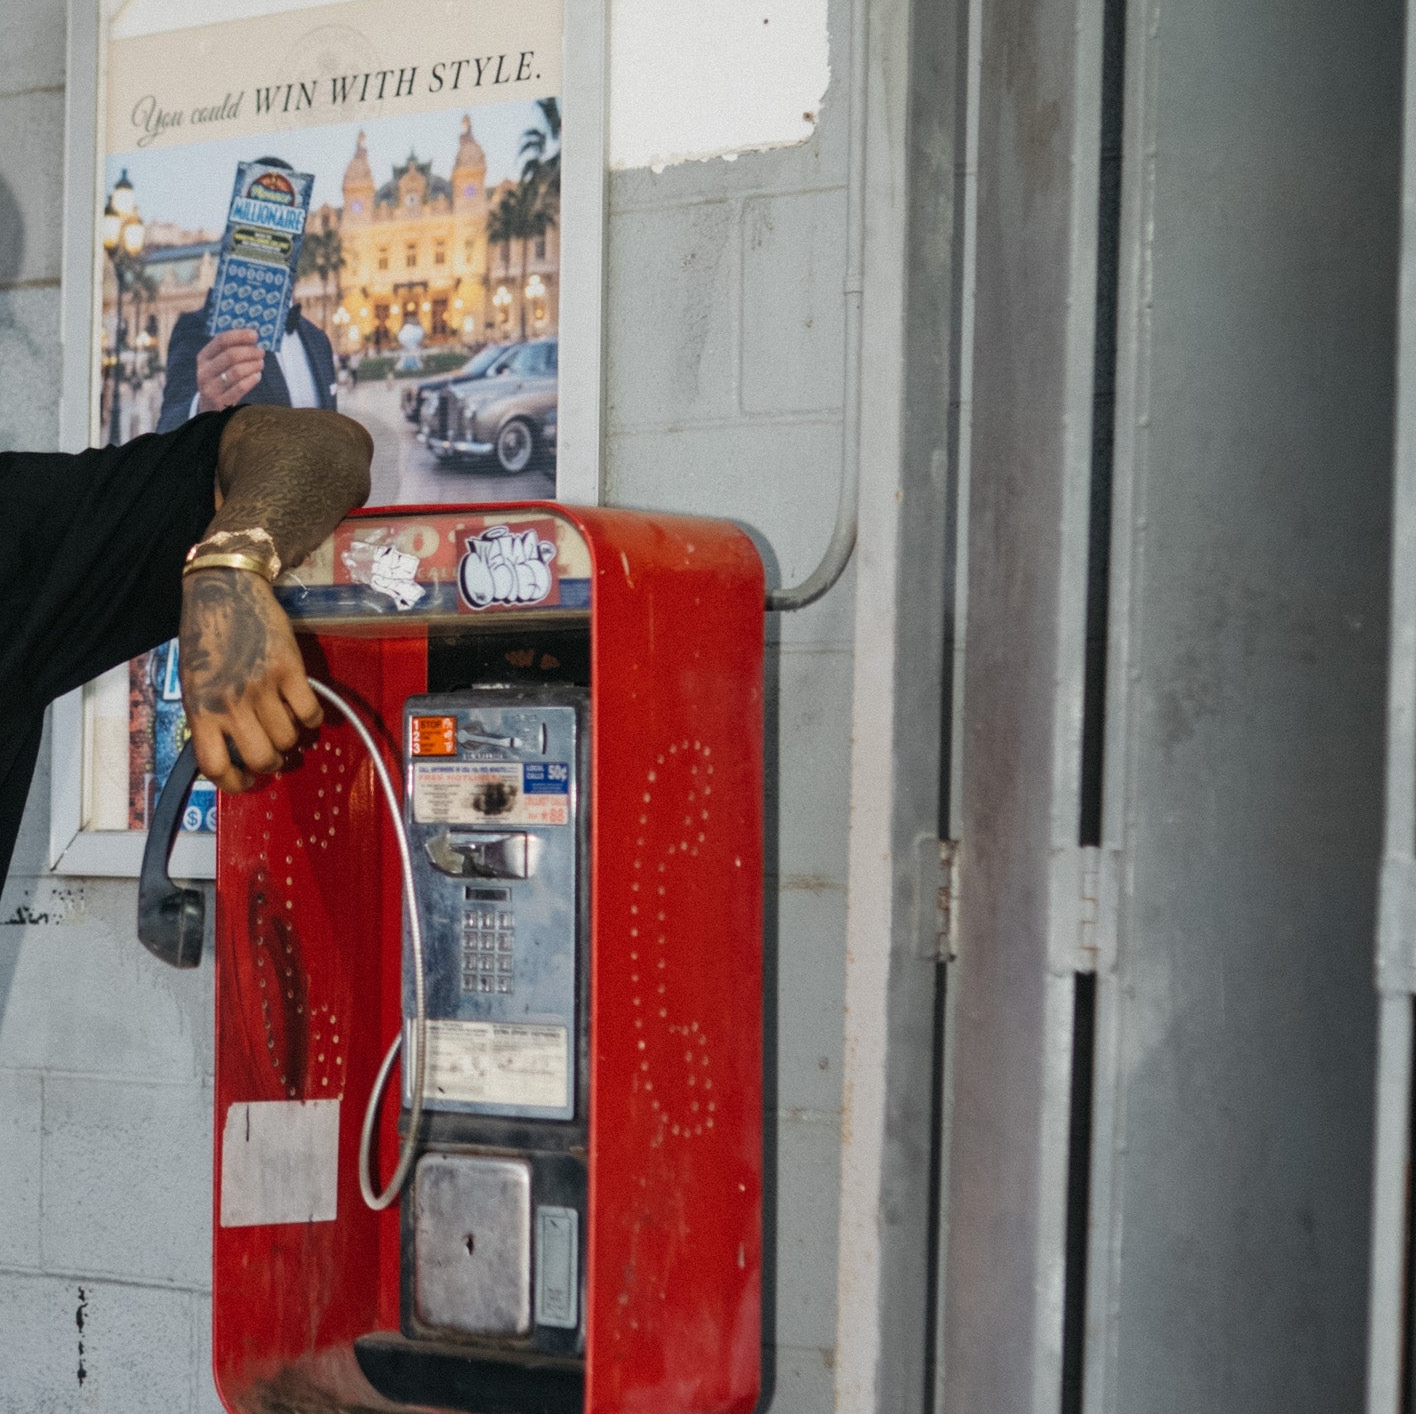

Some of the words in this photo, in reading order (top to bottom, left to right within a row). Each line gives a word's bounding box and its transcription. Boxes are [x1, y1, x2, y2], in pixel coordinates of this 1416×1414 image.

[131, 95, 183, 148] You
[190, 91, 244, 124] could
[256, 80, 318, 114] WIN
[331, 66, 419, 105] WITH
[429, 51, 541, 93] STYLE.
[233, 200, 304, 231] MILLIONAIRE
[413, 731, 421, 742] 2
[413, 743, 421, 754] 3
